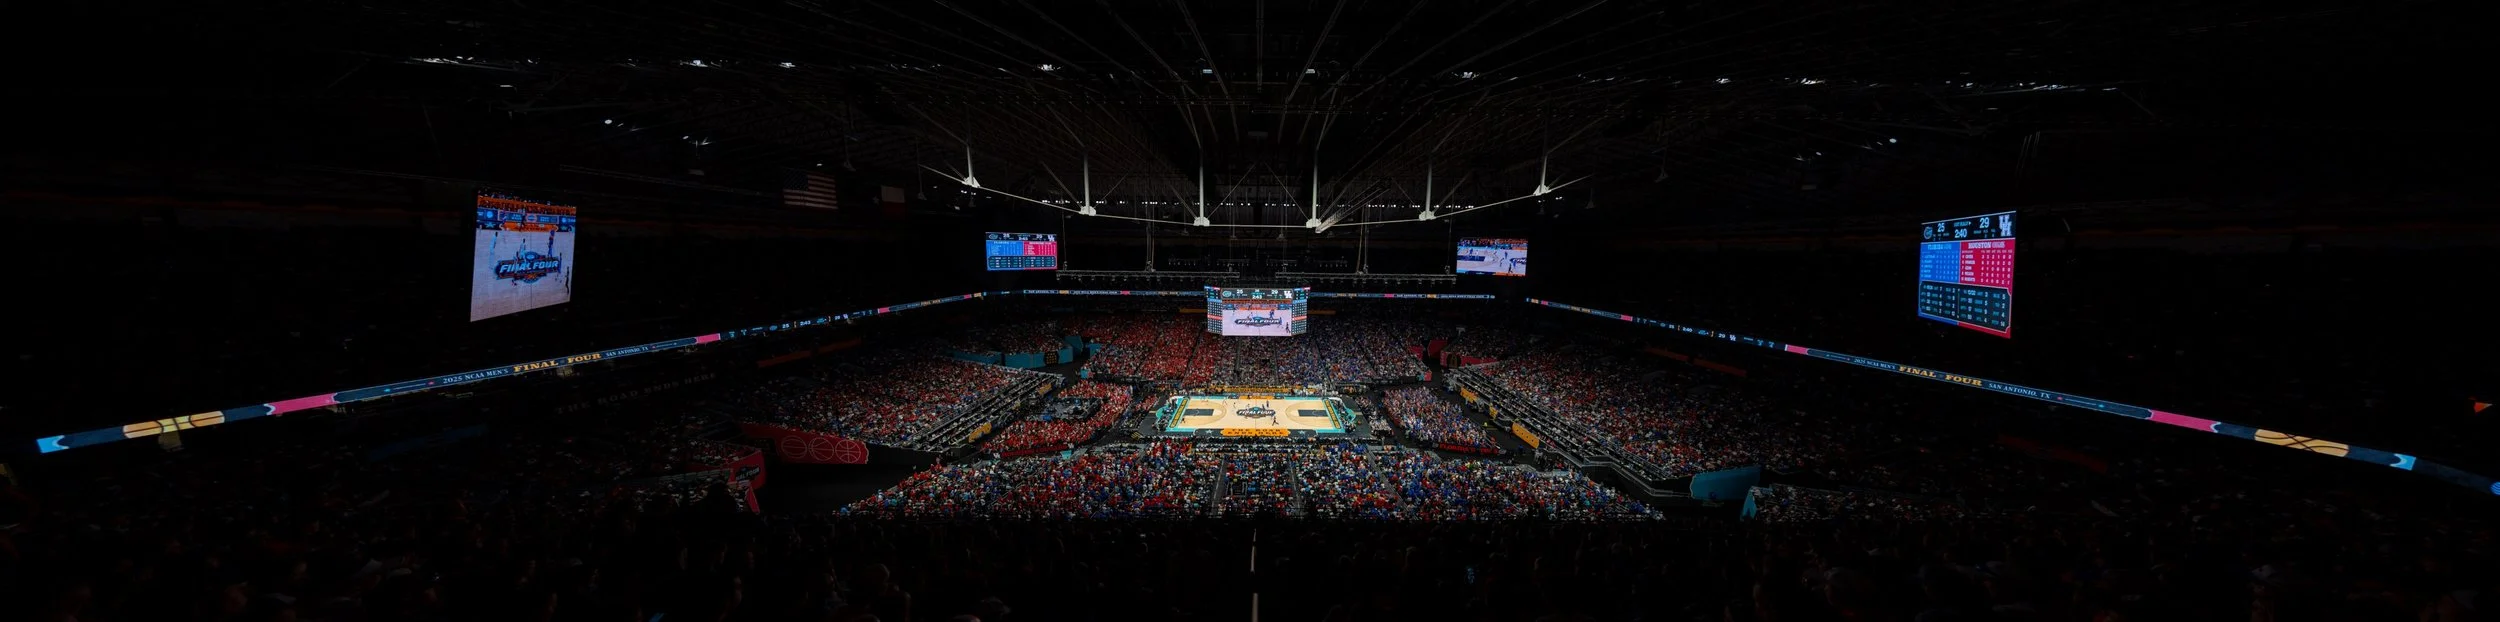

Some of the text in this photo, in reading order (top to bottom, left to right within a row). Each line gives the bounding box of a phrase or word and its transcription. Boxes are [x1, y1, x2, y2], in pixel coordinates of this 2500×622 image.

[1937, 222, 1945, 232] 25
[1979, 217, 1990, 229] 29
[499, 260, 559, 274] FINAL FOUR
[442, 375, 463, 384] 2025
[464, 372, 485, 381] NCAA
[486, 368, 509, 377] MEN'S
[513, 360, 559, 373] FINAL
[567, 353, 602, 364] FOUR
[1898, 365, 1937, 378] FINAL
[1944, 374, 1983, 386] FOUR
